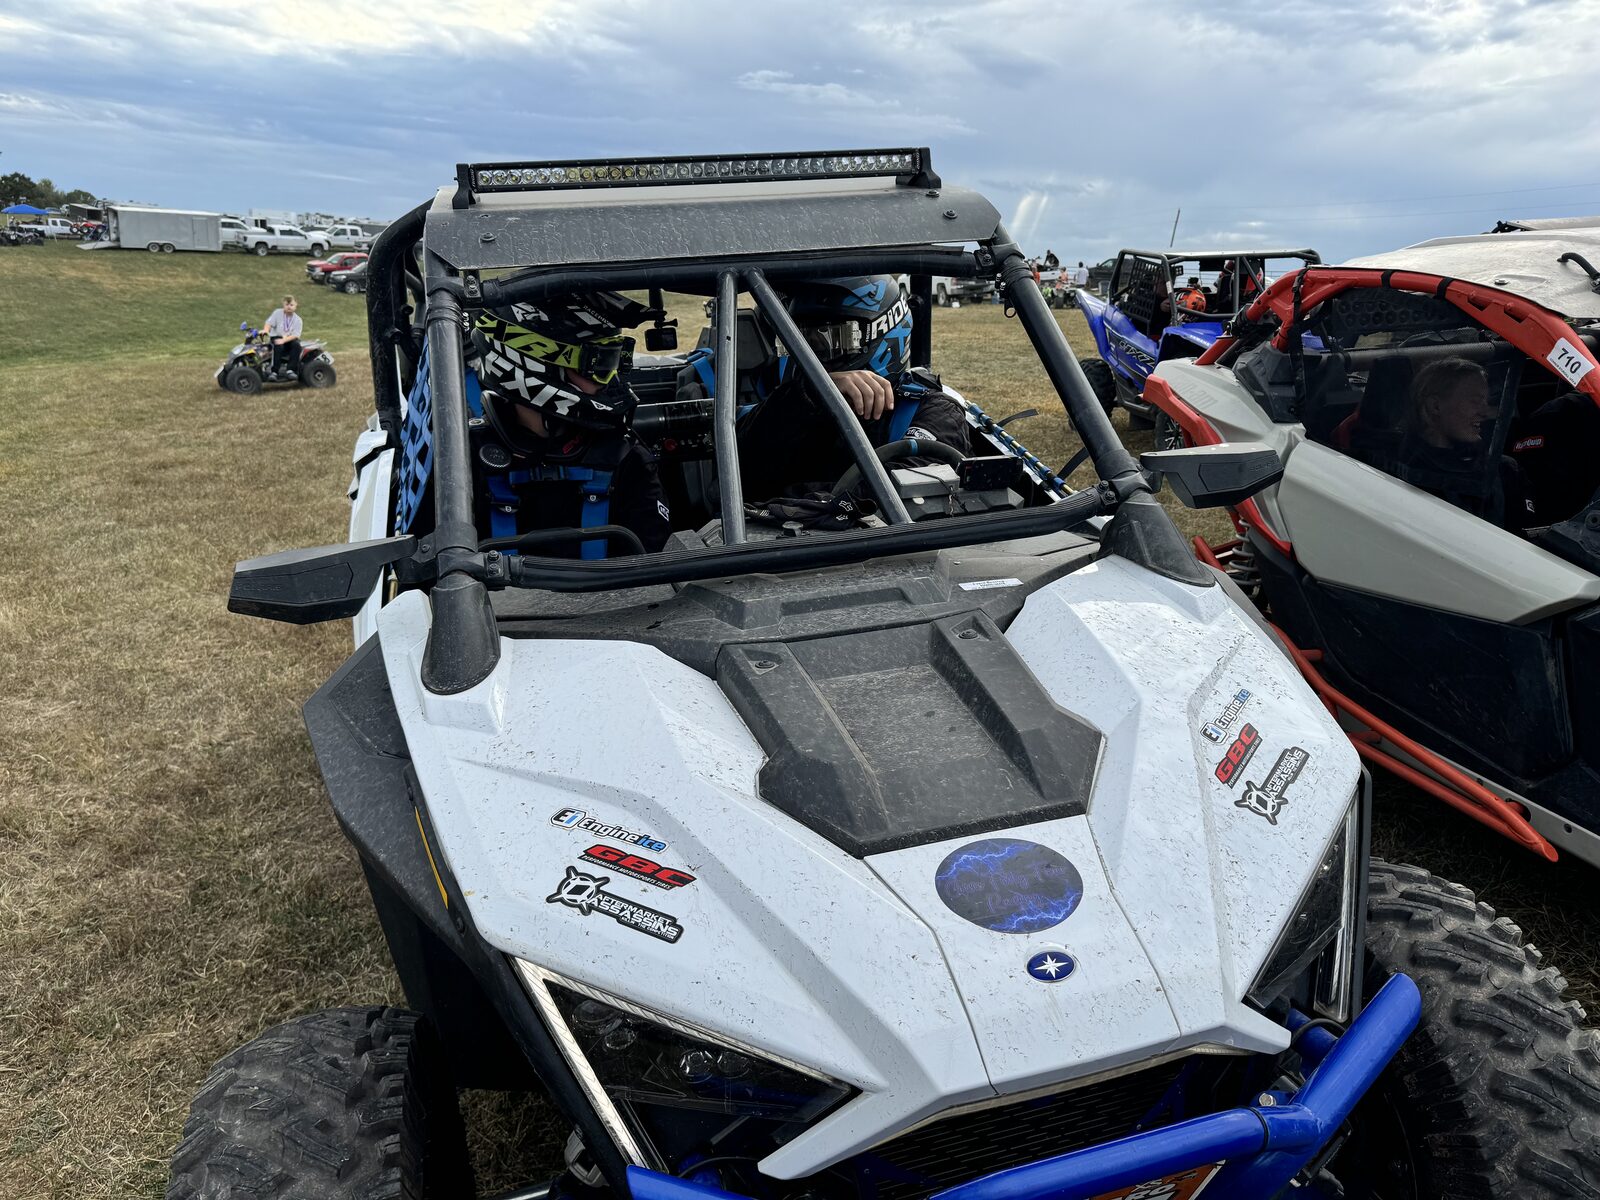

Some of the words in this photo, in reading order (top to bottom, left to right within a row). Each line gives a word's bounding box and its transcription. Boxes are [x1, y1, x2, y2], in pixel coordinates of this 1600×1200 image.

[1557, 347, 1582, 374] 710
[1215, 724, 1258, 783] GBC
[1265, 751, 1292, 793] AFTERMARKET
[1269, 749, 1303, 800] ASSASSINS
[582, 855, 619, 871] PERFORMANCE
[619, 867, 656, 885] MOTORSPORTS
[584, 844, 696, 887] GBC
[587, 898, 679, 937] ASSASSINS
[595, 894, 673, 926] AFTERMARKET
